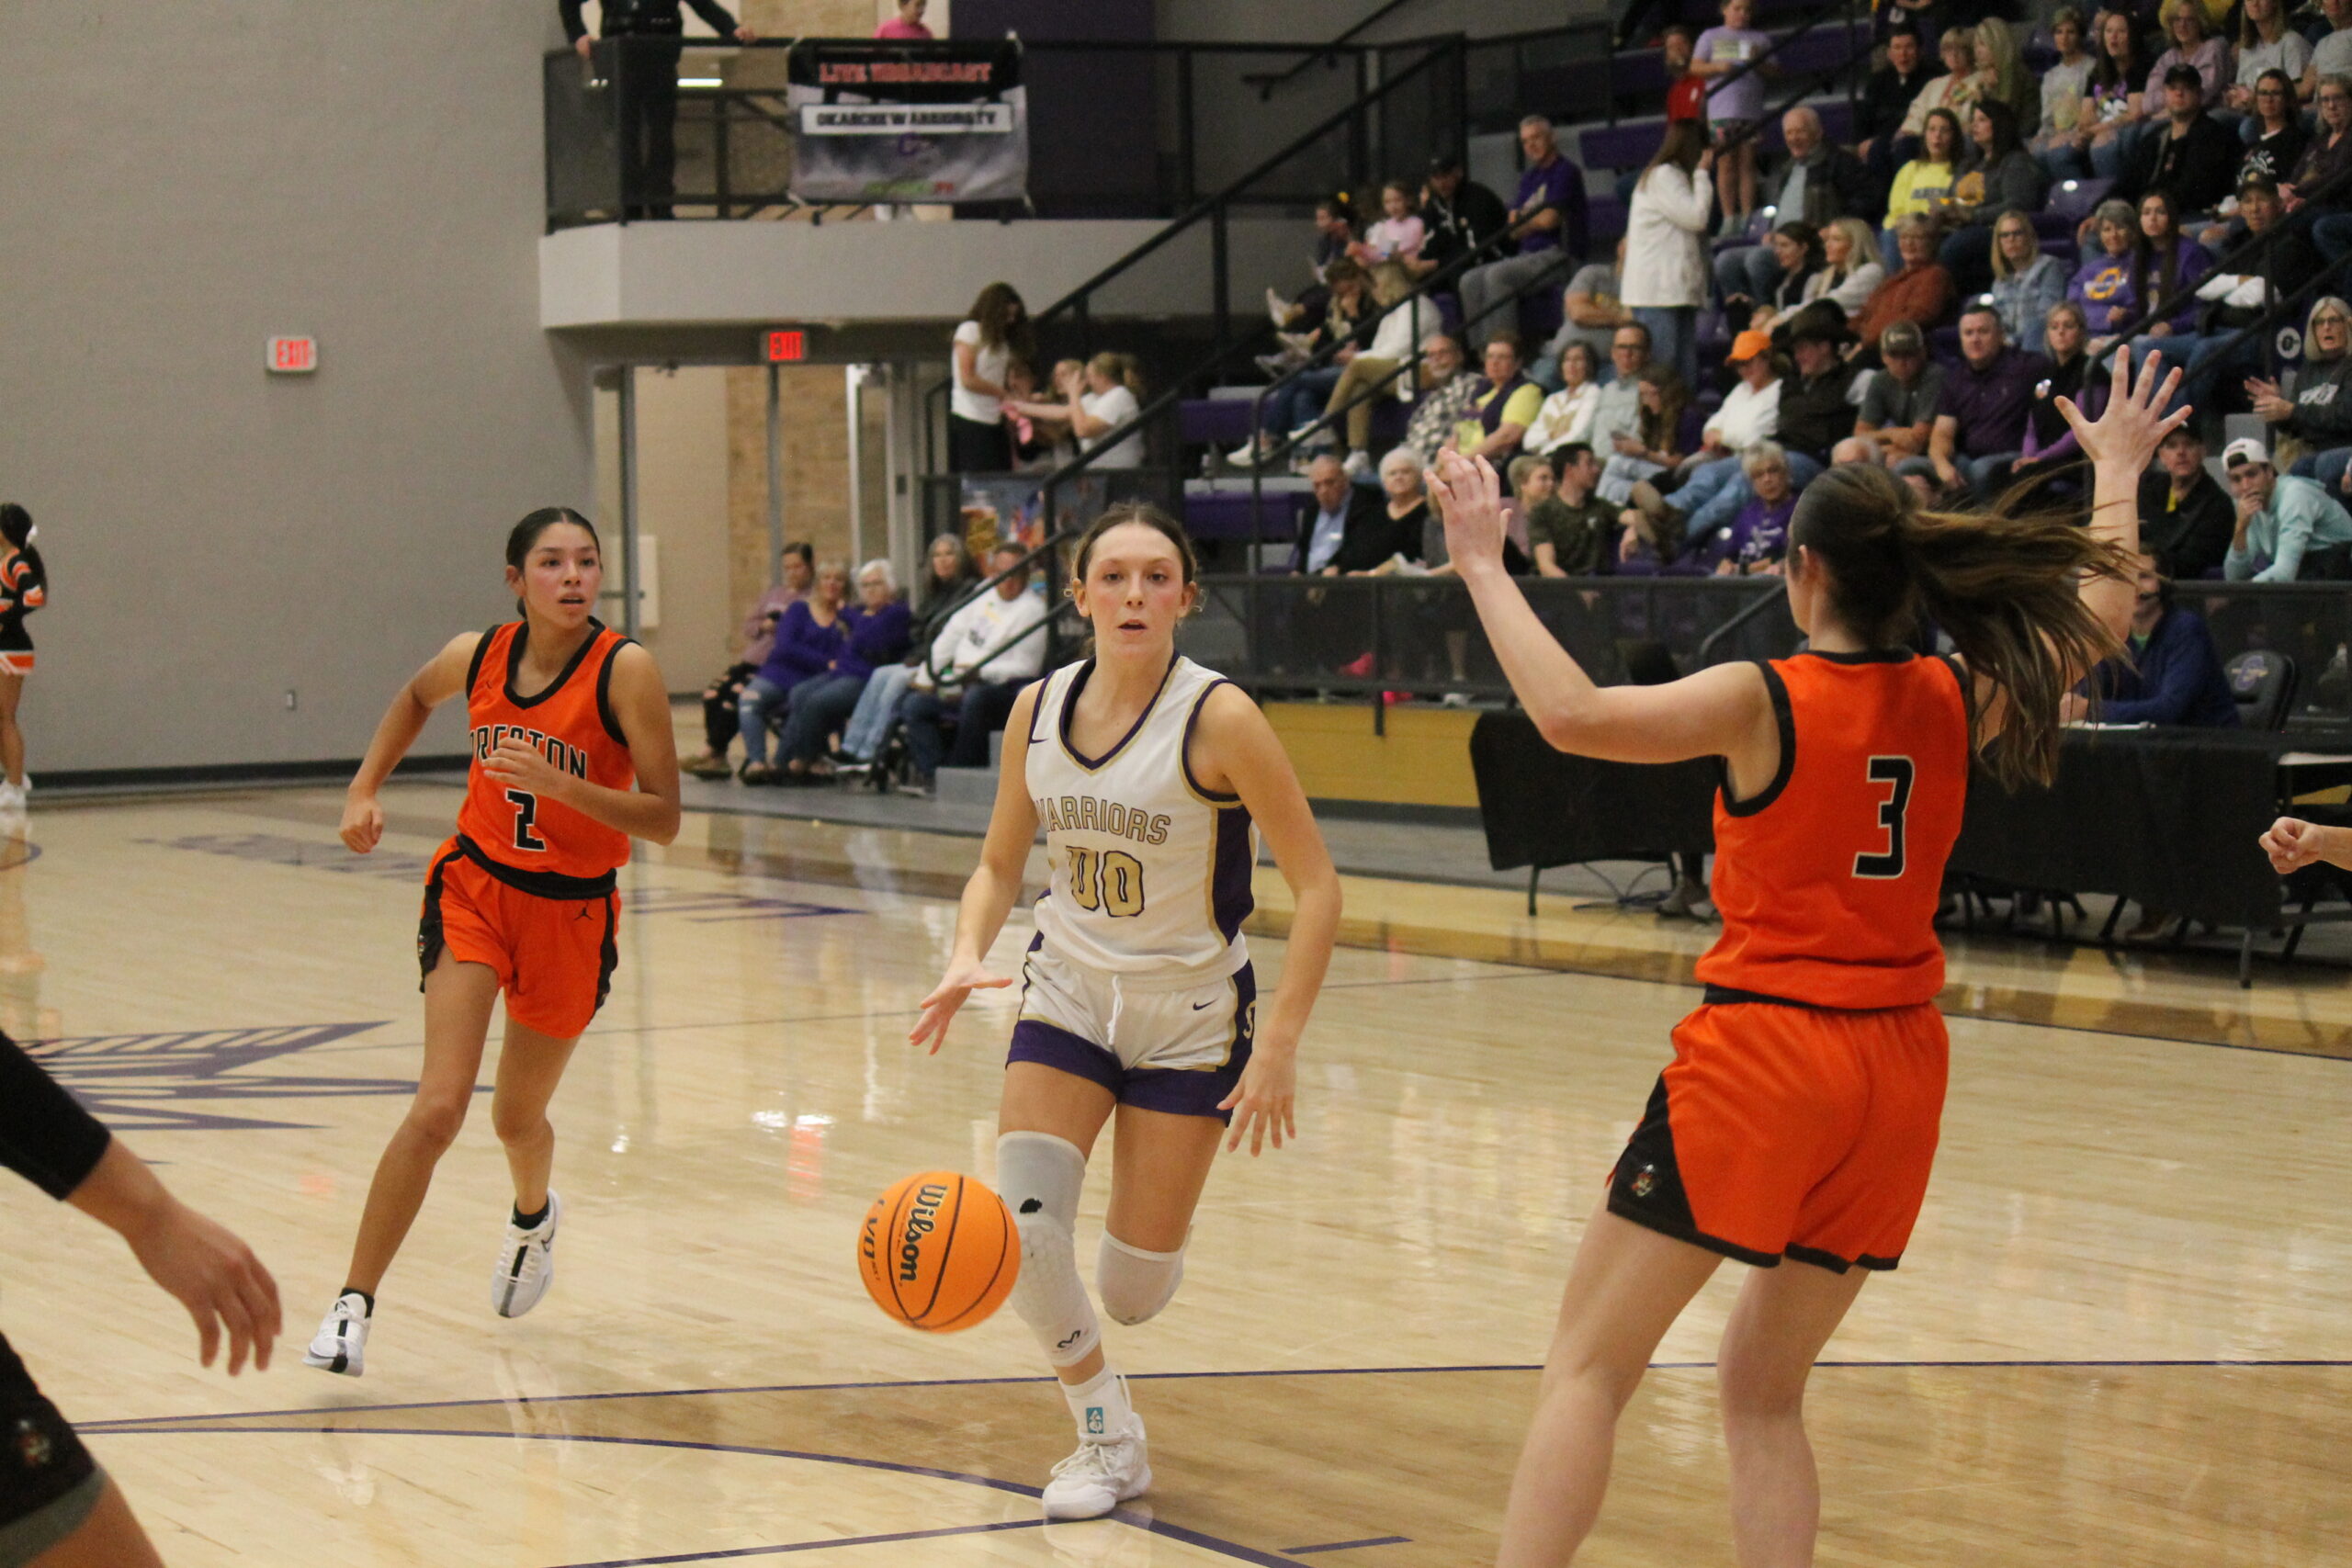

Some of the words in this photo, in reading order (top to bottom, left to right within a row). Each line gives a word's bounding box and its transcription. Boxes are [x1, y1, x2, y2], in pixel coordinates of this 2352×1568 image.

[277, 339, 310, 368] EXIT
[769, 331, 803, 360] EXIT
[470, 724, 587, 780] RETON
[505, 788, 547, 852] 2
[1035, 795, 1171, 845] WARRIORS
[1851, 755, 1916, 879] 3
[1065, 844, 1146, 918] 00
[899, 1184, 949, 1281] Wilson
